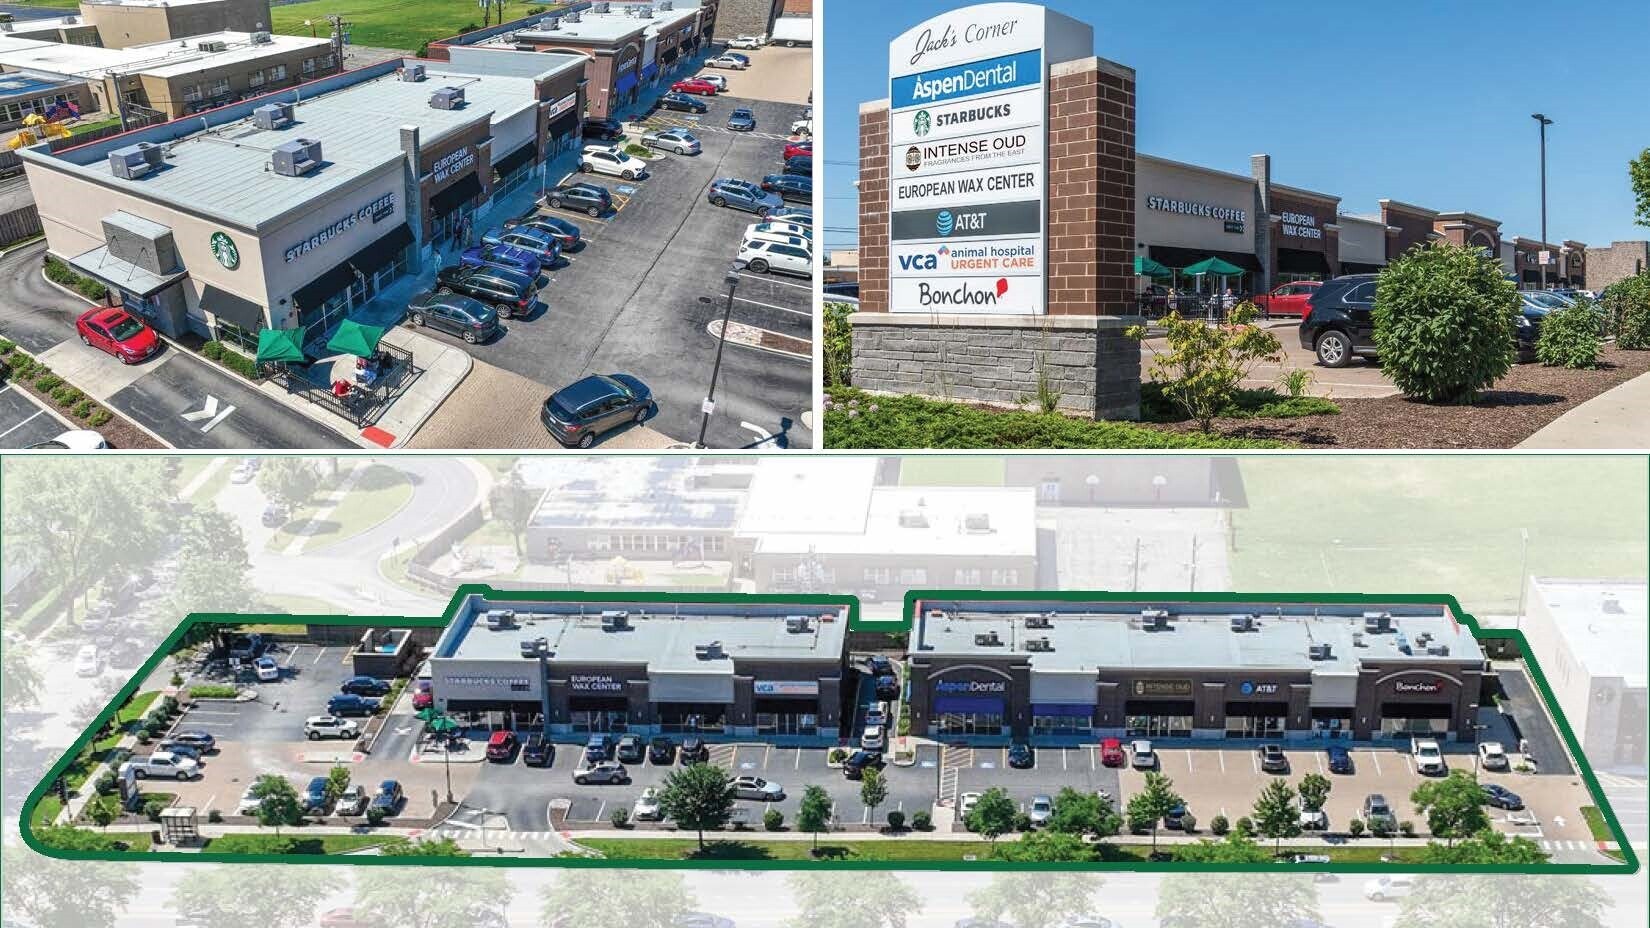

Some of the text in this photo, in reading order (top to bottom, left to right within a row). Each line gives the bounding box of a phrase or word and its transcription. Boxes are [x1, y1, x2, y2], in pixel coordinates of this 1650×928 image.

[911, 20, 1018, 65] Jack's Corner
[912, 60, 1017, 101] AspenDental
[936, 103, 1011, 127] STARBUCKS
[923, 134, 1026, 159] INTENSE OUD
[433, 146, 468, 173] EUROPEAN
[923, 148, 1025, 167] FRAGRANCES FROM THE EAST
[434, 154, 474, 184] WAX CENTER
[898, 172, 1034, 200] EUROPEAN WAX CENTER
[1149, 196, 1246, 223] STARBUCKS COFFEE
[1282, 211, 1315, 227] EUROPEAN
[285, 214, 358, 263] STARBUCKS
[358, 192, 396, 221] COFFEE
[954, 212, 988, 231] AT&T
[1282, 224, 1321, 239] WAX CENTER
[898, 253, 938, 271] vca
[951, 245, 1035, 260] animal hospital
[951, 257, 1034, 270] URGENT CARE
[918, 281, 997, 306] Bonchon
[571, 674, 612, 682] EUROPEAN
[572, 682, 622, 690] WAX CENTER
[1256, 683, 1278, 693] AT&T
